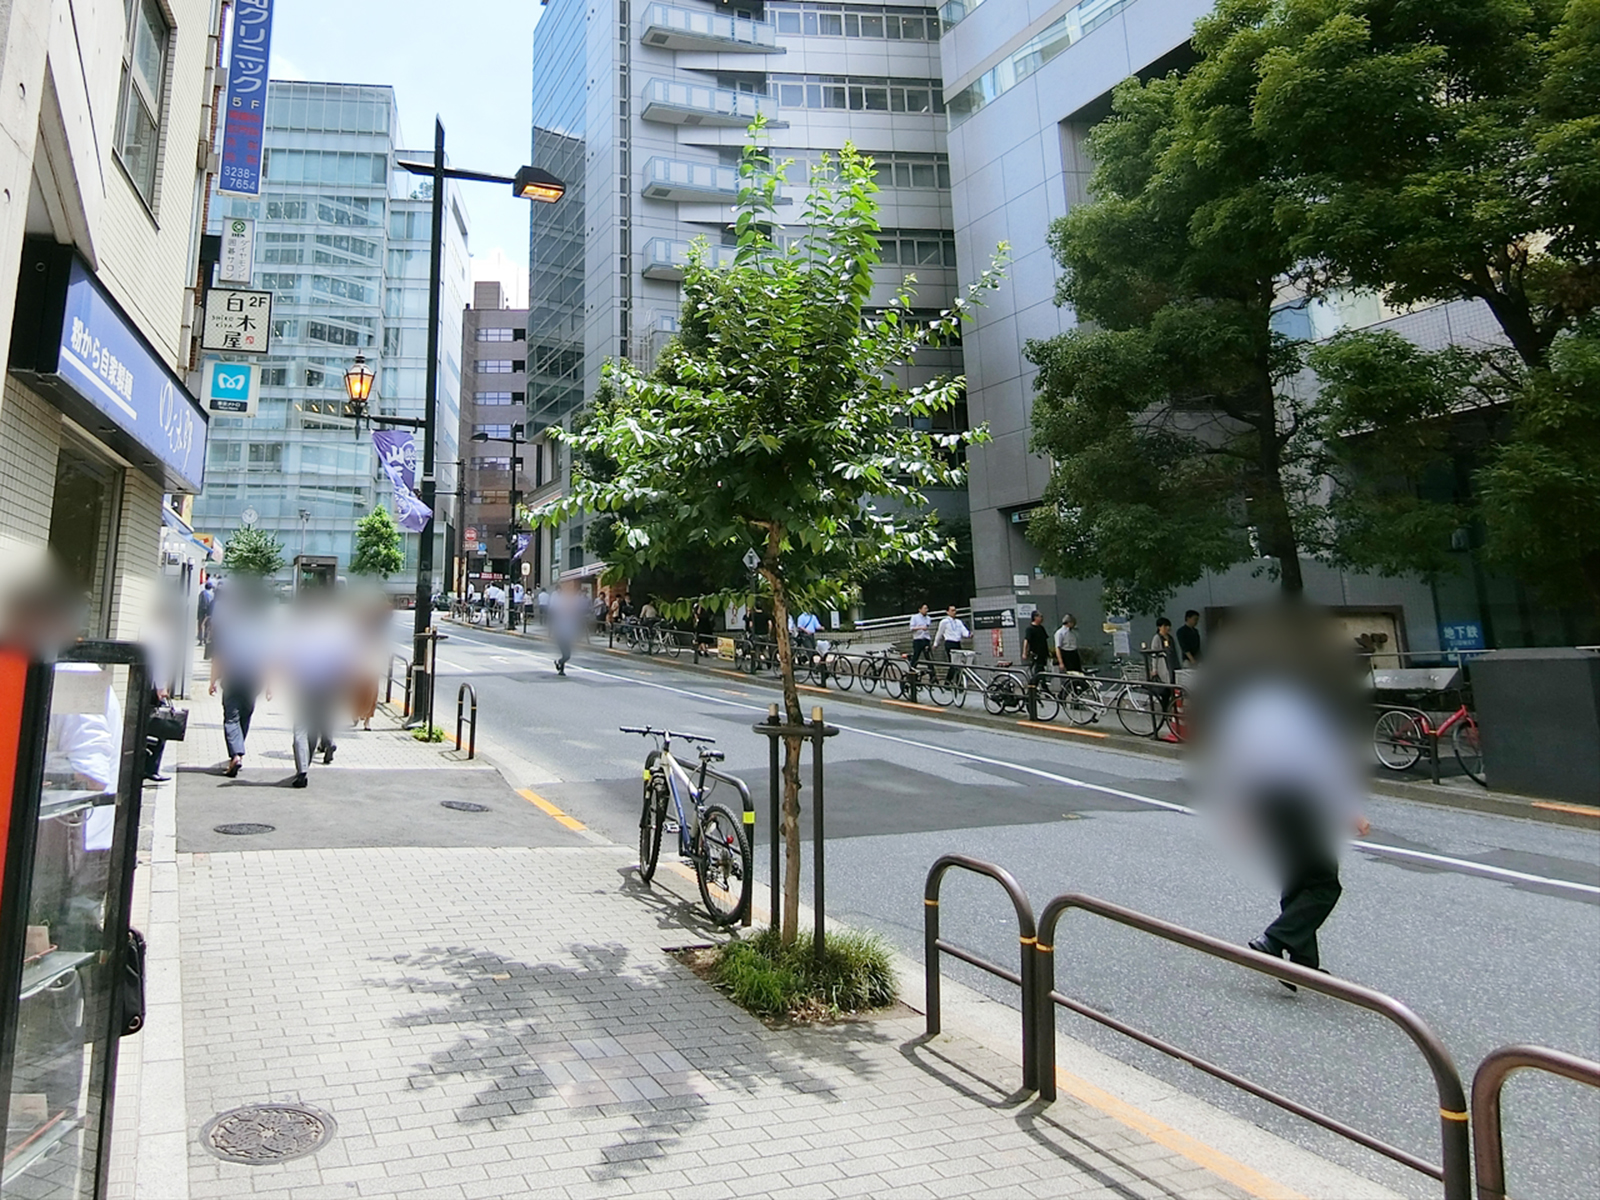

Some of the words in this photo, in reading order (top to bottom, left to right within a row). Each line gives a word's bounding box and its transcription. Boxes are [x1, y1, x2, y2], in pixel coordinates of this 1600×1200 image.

[224, 166, 256, 178] 3238-
[230, 178, 255, 190] 7654
[238, 239, 250, 279] ダイヤモンド
[249, 296, 267, 307] 2F
[70, 316, 134, 402] 粉から自家製麺
[1443, 625, 1478, 639] 地下鉄
